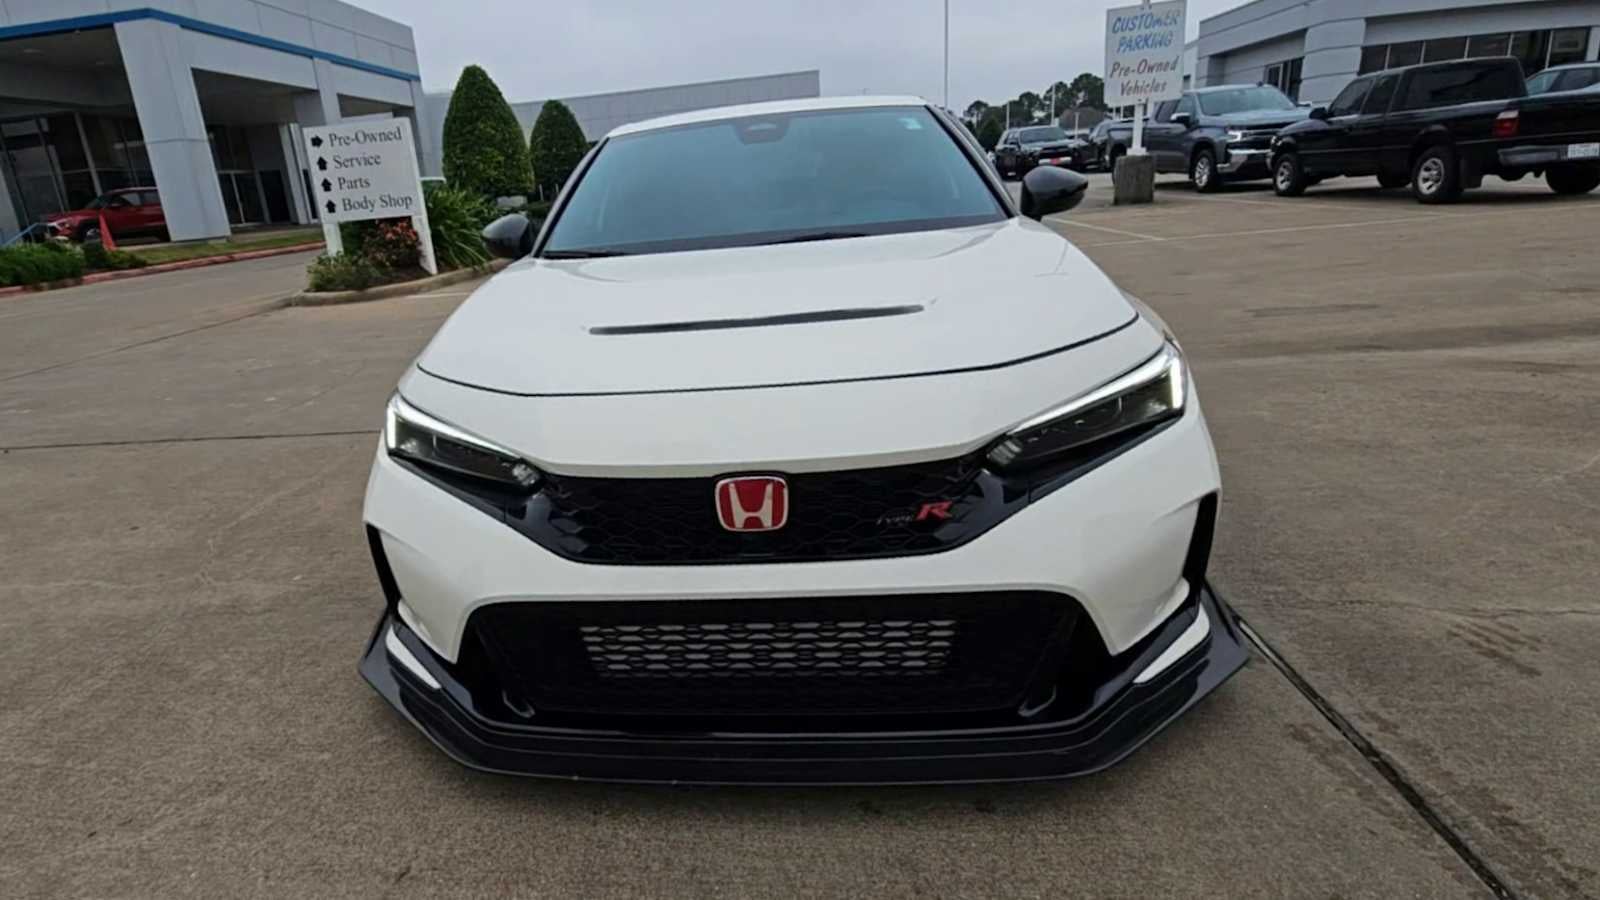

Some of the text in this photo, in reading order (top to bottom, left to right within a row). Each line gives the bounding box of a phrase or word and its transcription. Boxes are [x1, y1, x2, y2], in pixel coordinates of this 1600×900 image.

[1116, 31, 1173, 53] PARKING
[1110, 55, 1180, 79] Pre-Owned
[1121, 77, 1167, 97] Vehicles
[328, 127, 402, 147] Pre-Owned
[333, 153, 381, 169] Service
[338, 177, 371, 190] Parts
[342, 195, 413, 213] Body Shop
[915, 500, 953, 521] R
